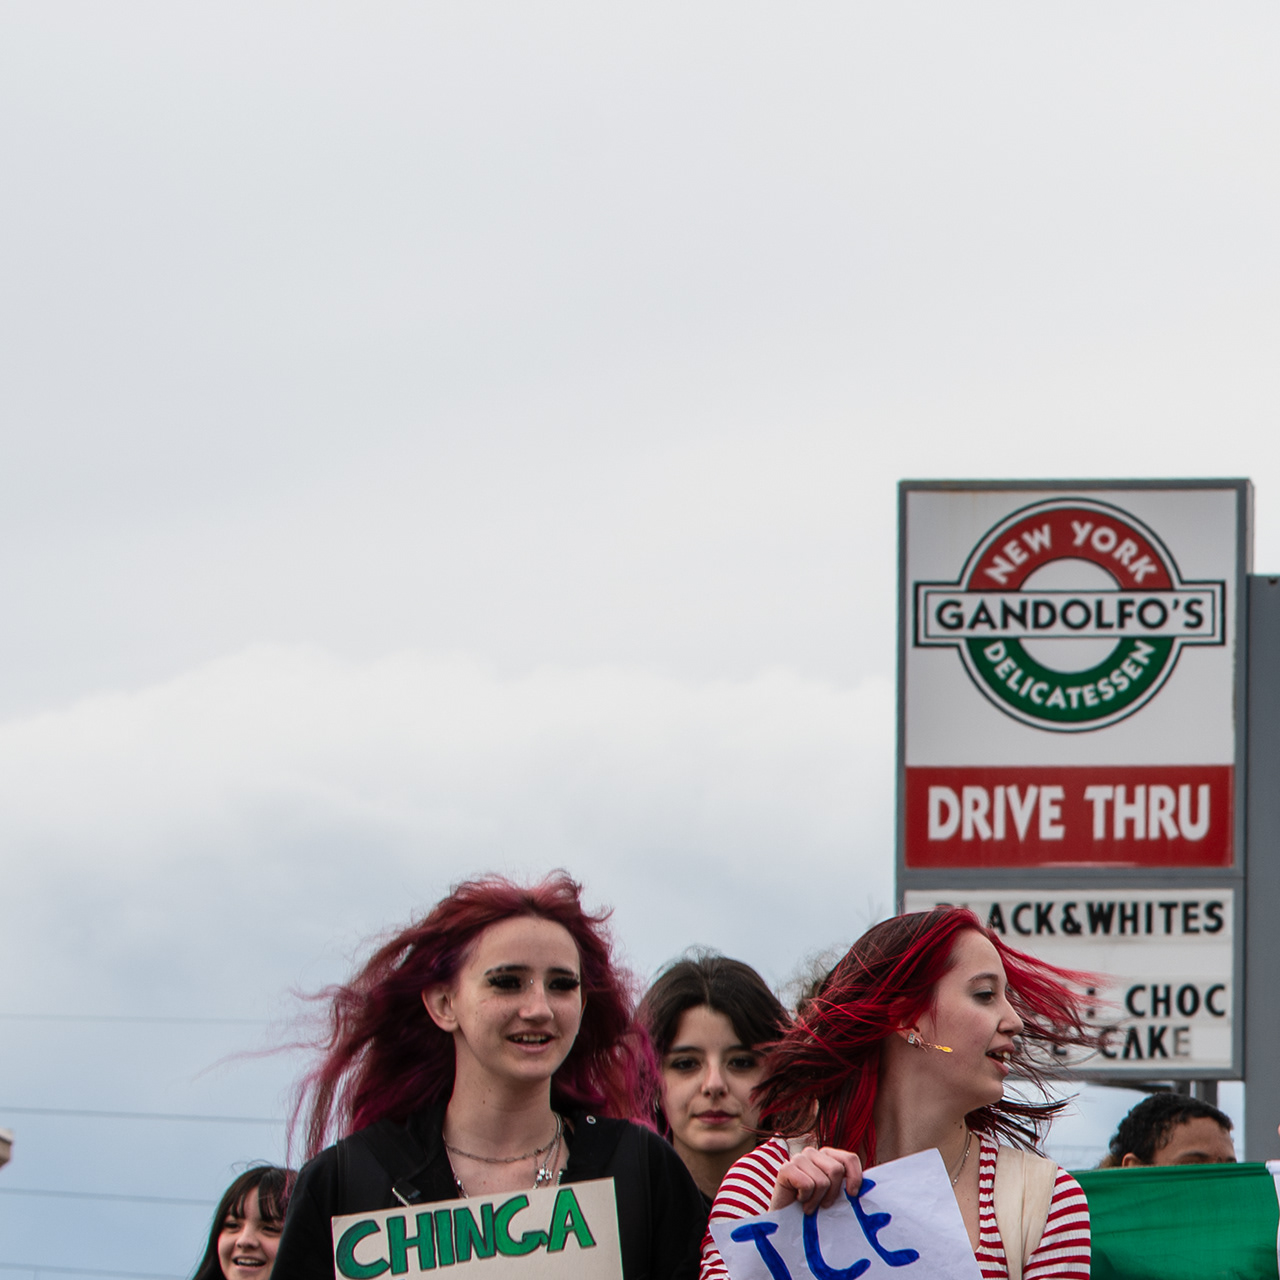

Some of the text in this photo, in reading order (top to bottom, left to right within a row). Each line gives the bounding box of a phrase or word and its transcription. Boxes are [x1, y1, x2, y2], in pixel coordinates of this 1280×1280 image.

[984, 520, 1159, 585] NEW YORK
[935, 598, 1205, 631] GANDOLFO'S
[983, 639, 1157, 710] DELICATESSEN
[928, 783, 1212, 843] DRIVE THRU
[936, 900, 1225, 937] ACK&WHITES
[1125, 983, 1228, 1018] CHOC
[336, 1187, 597, 1280] CHINGA
